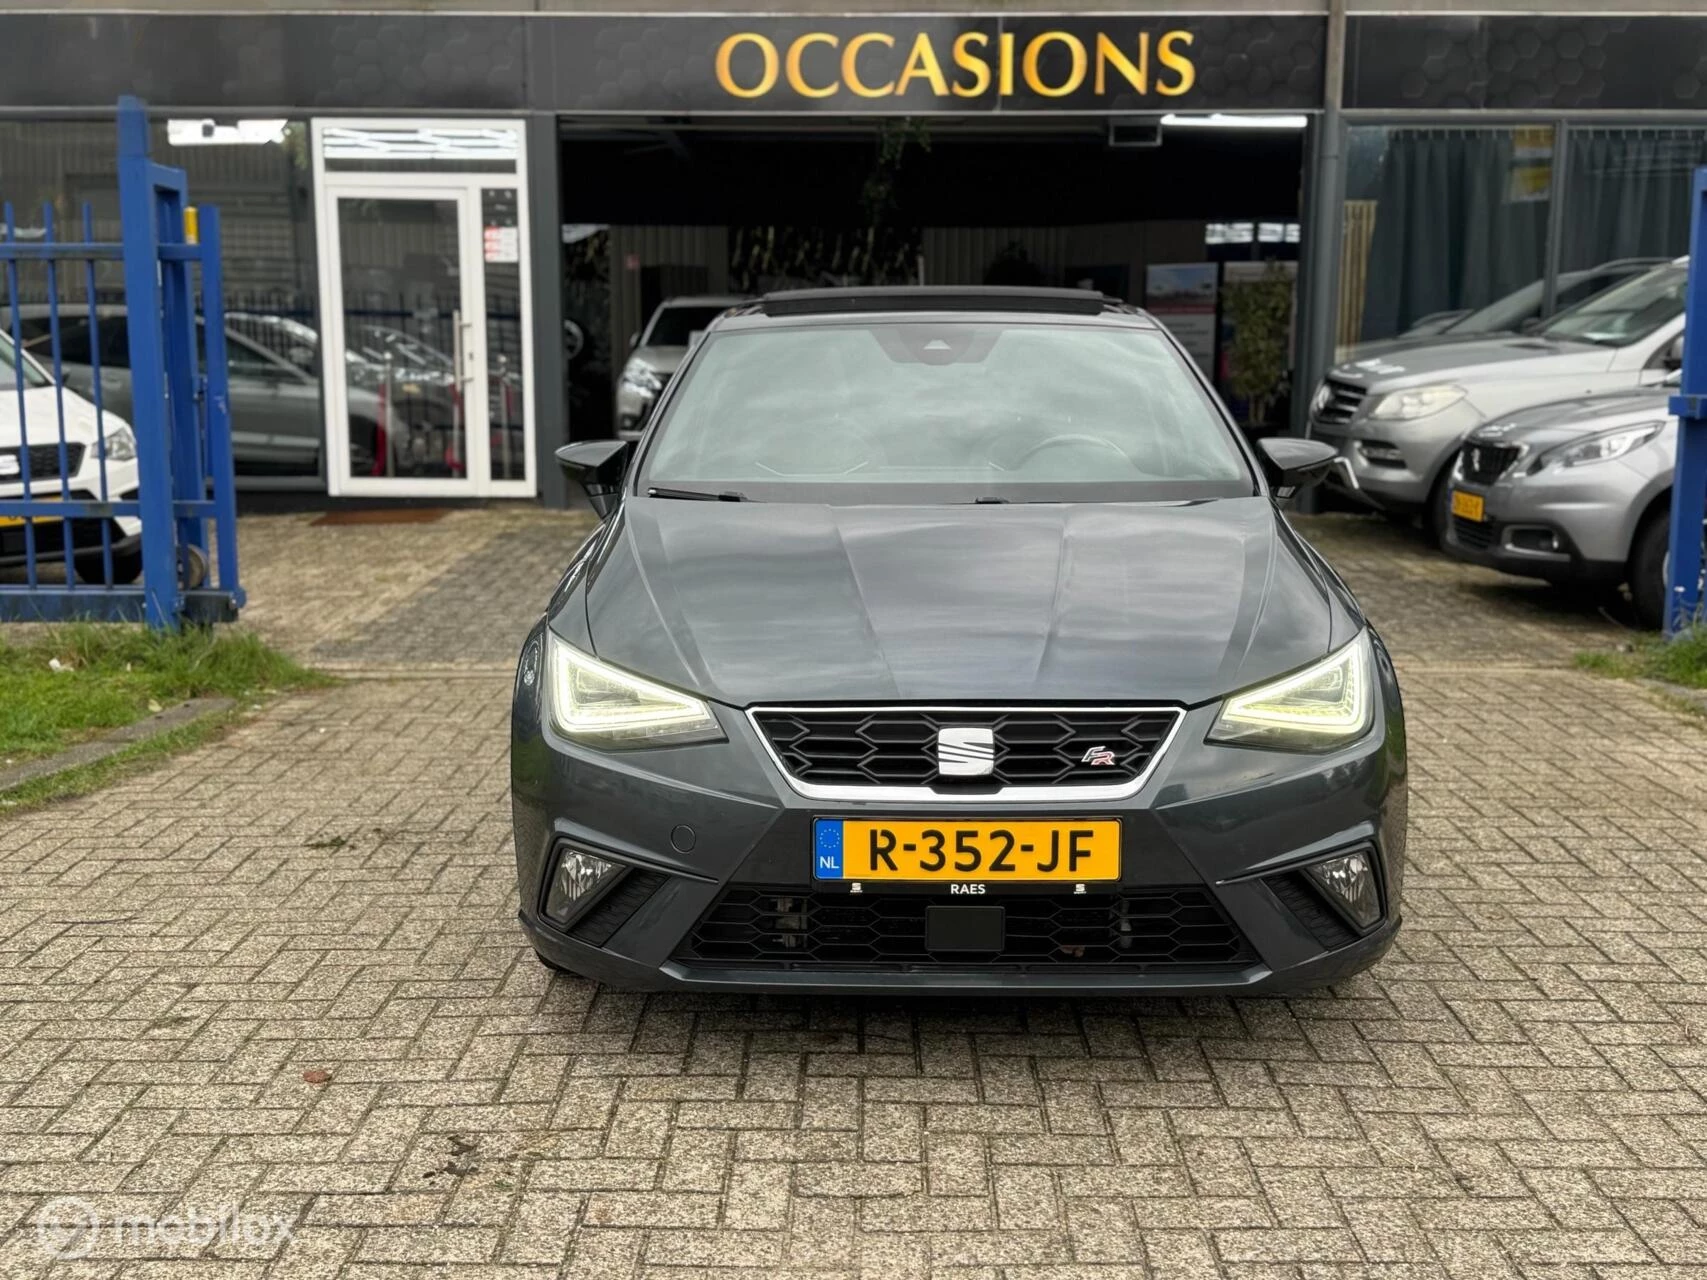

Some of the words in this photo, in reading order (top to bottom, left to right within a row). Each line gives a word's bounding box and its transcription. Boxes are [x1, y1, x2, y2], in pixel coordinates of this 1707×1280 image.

[714, 30, 1196, 99] OCCASIONS
[819, 856, 839, 869] NL
[869, 829, 1094, 872] R-352-JF
[950, 883, 986, 895] RAES
